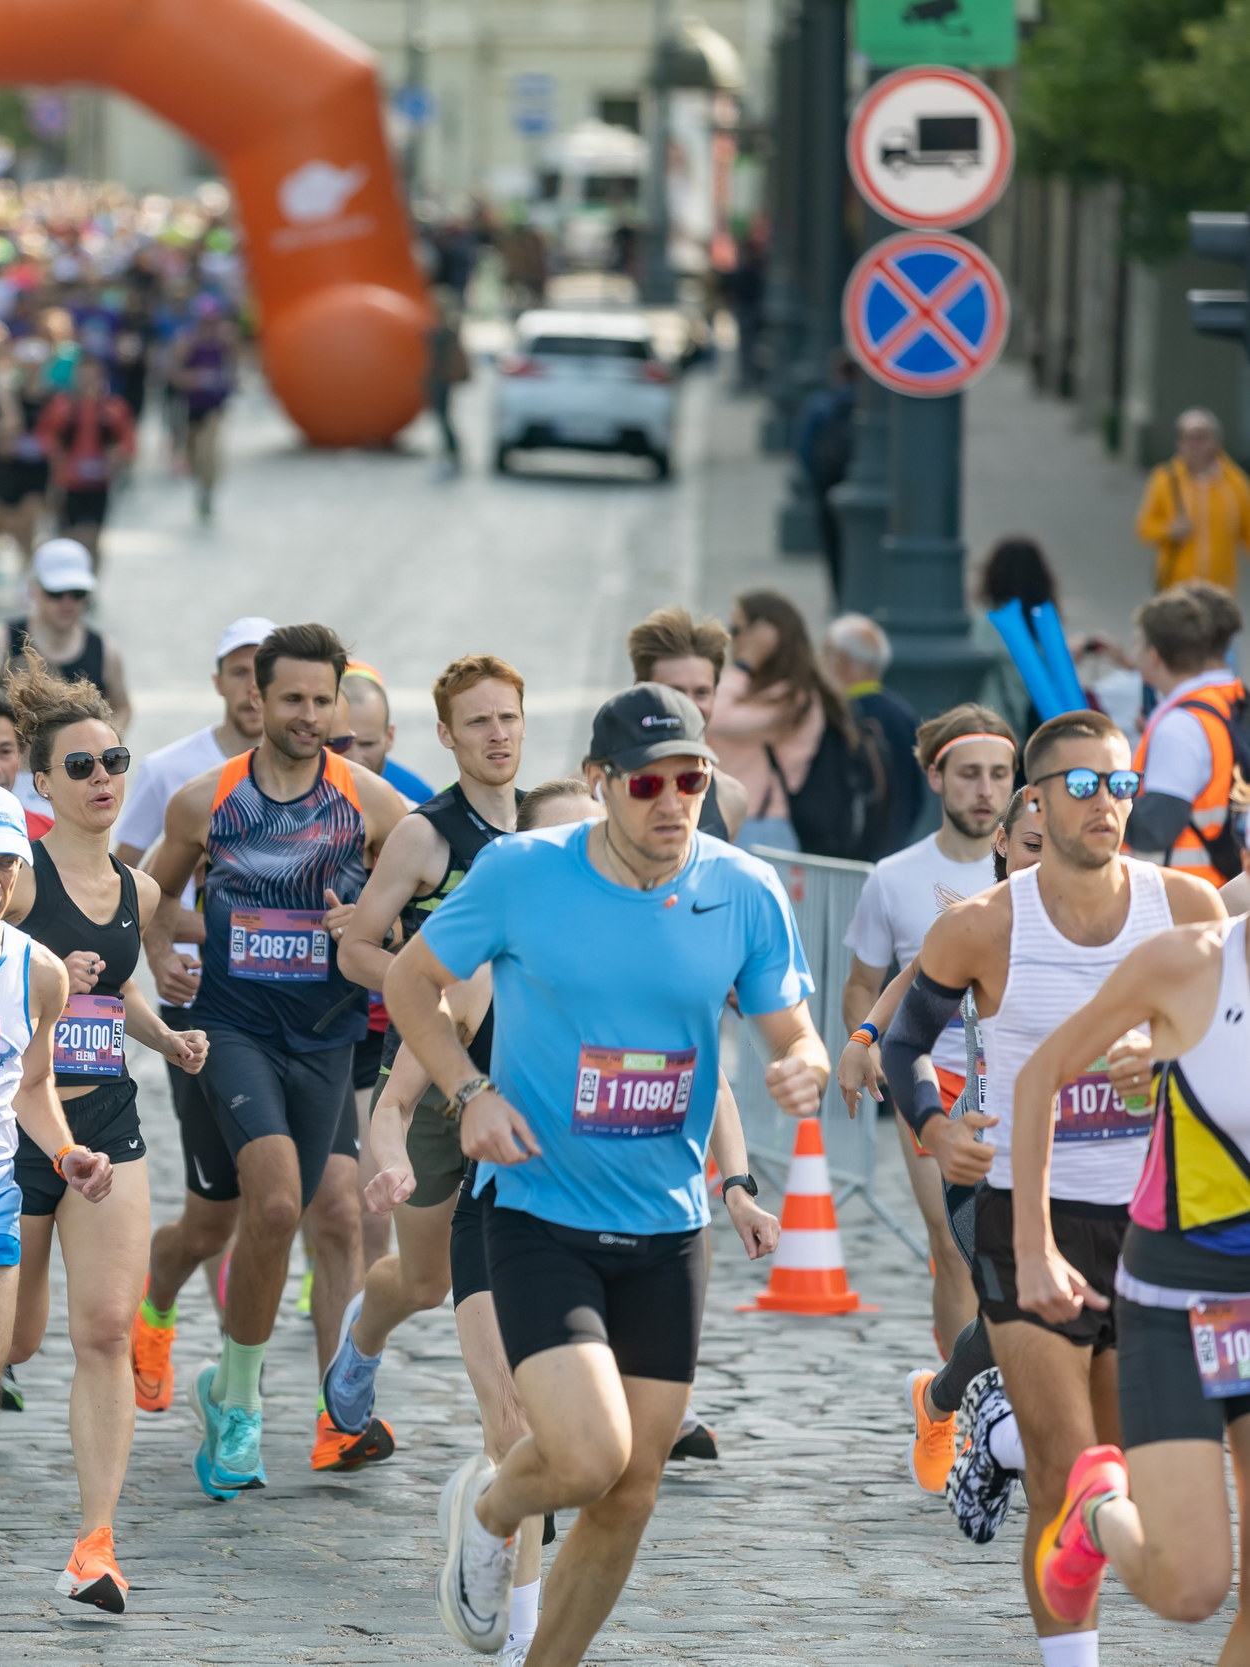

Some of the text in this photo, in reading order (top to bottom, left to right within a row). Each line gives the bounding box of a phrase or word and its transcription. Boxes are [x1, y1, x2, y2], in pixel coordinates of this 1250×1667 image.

[250, 934, 308, 959] 20879
[58, 1023, 110, 1050] 20100
[76, 1050, 96, 1061] ELENA
[606, 1079, 675, 1111] 11098
[1221, 1329, 1250, 1365] 10
